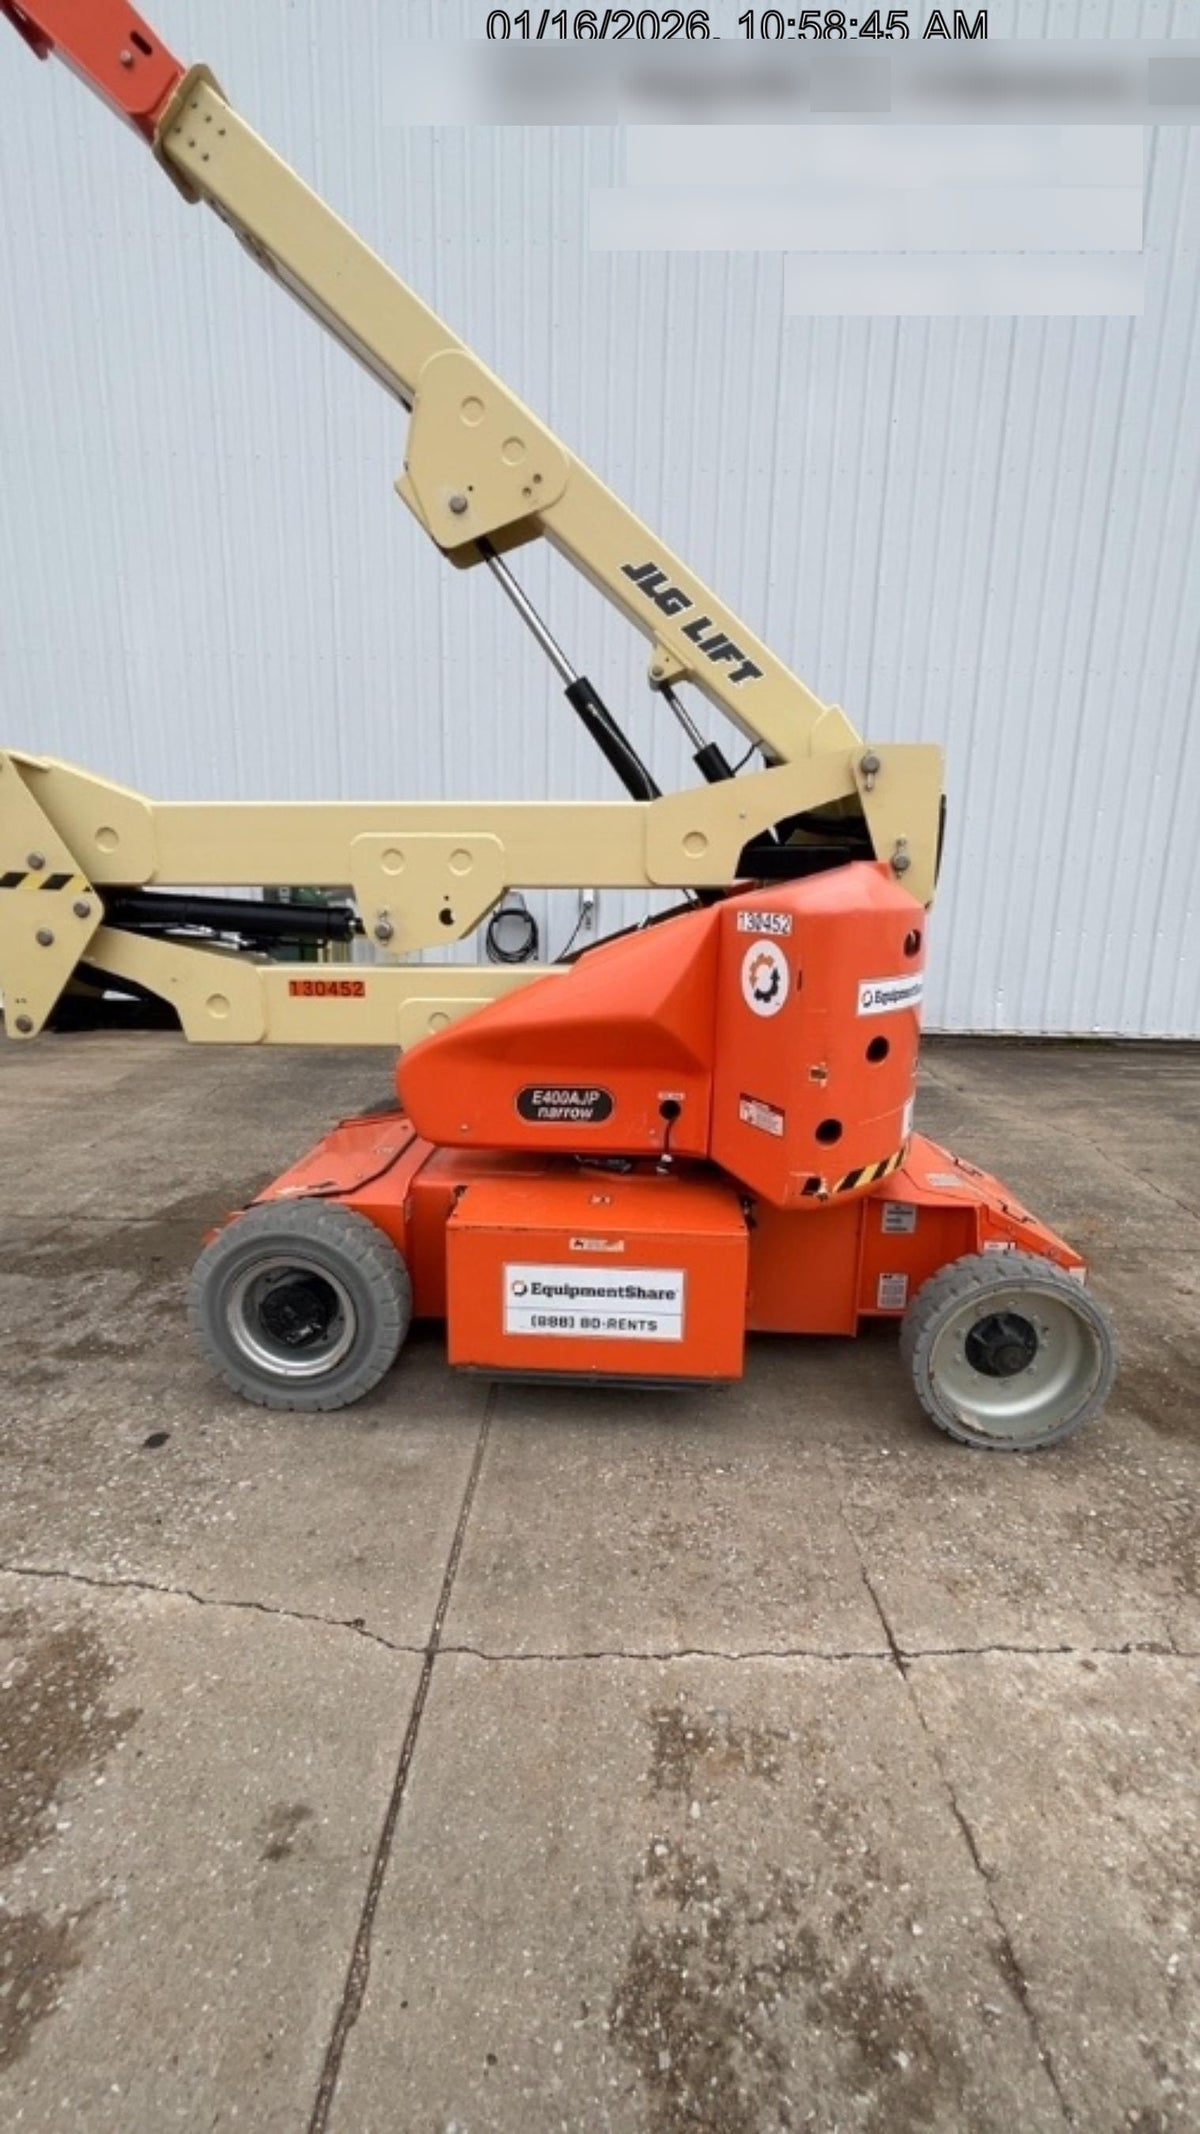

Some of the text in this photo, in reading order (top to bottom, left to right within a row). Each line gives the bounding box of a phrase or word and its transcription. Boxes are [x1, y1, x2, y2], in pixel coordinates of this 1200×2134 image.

[620, 560, 765, 684] JLG LIFT
[739, 911, 791, 935] 130452
[288, 980, 367, 998] 130452
[531, 1090, 600, 1106] E400AJP
[537, 1107, 594, 1119] narrow
[530, 1281, 677, 1301] EquipmentShare
